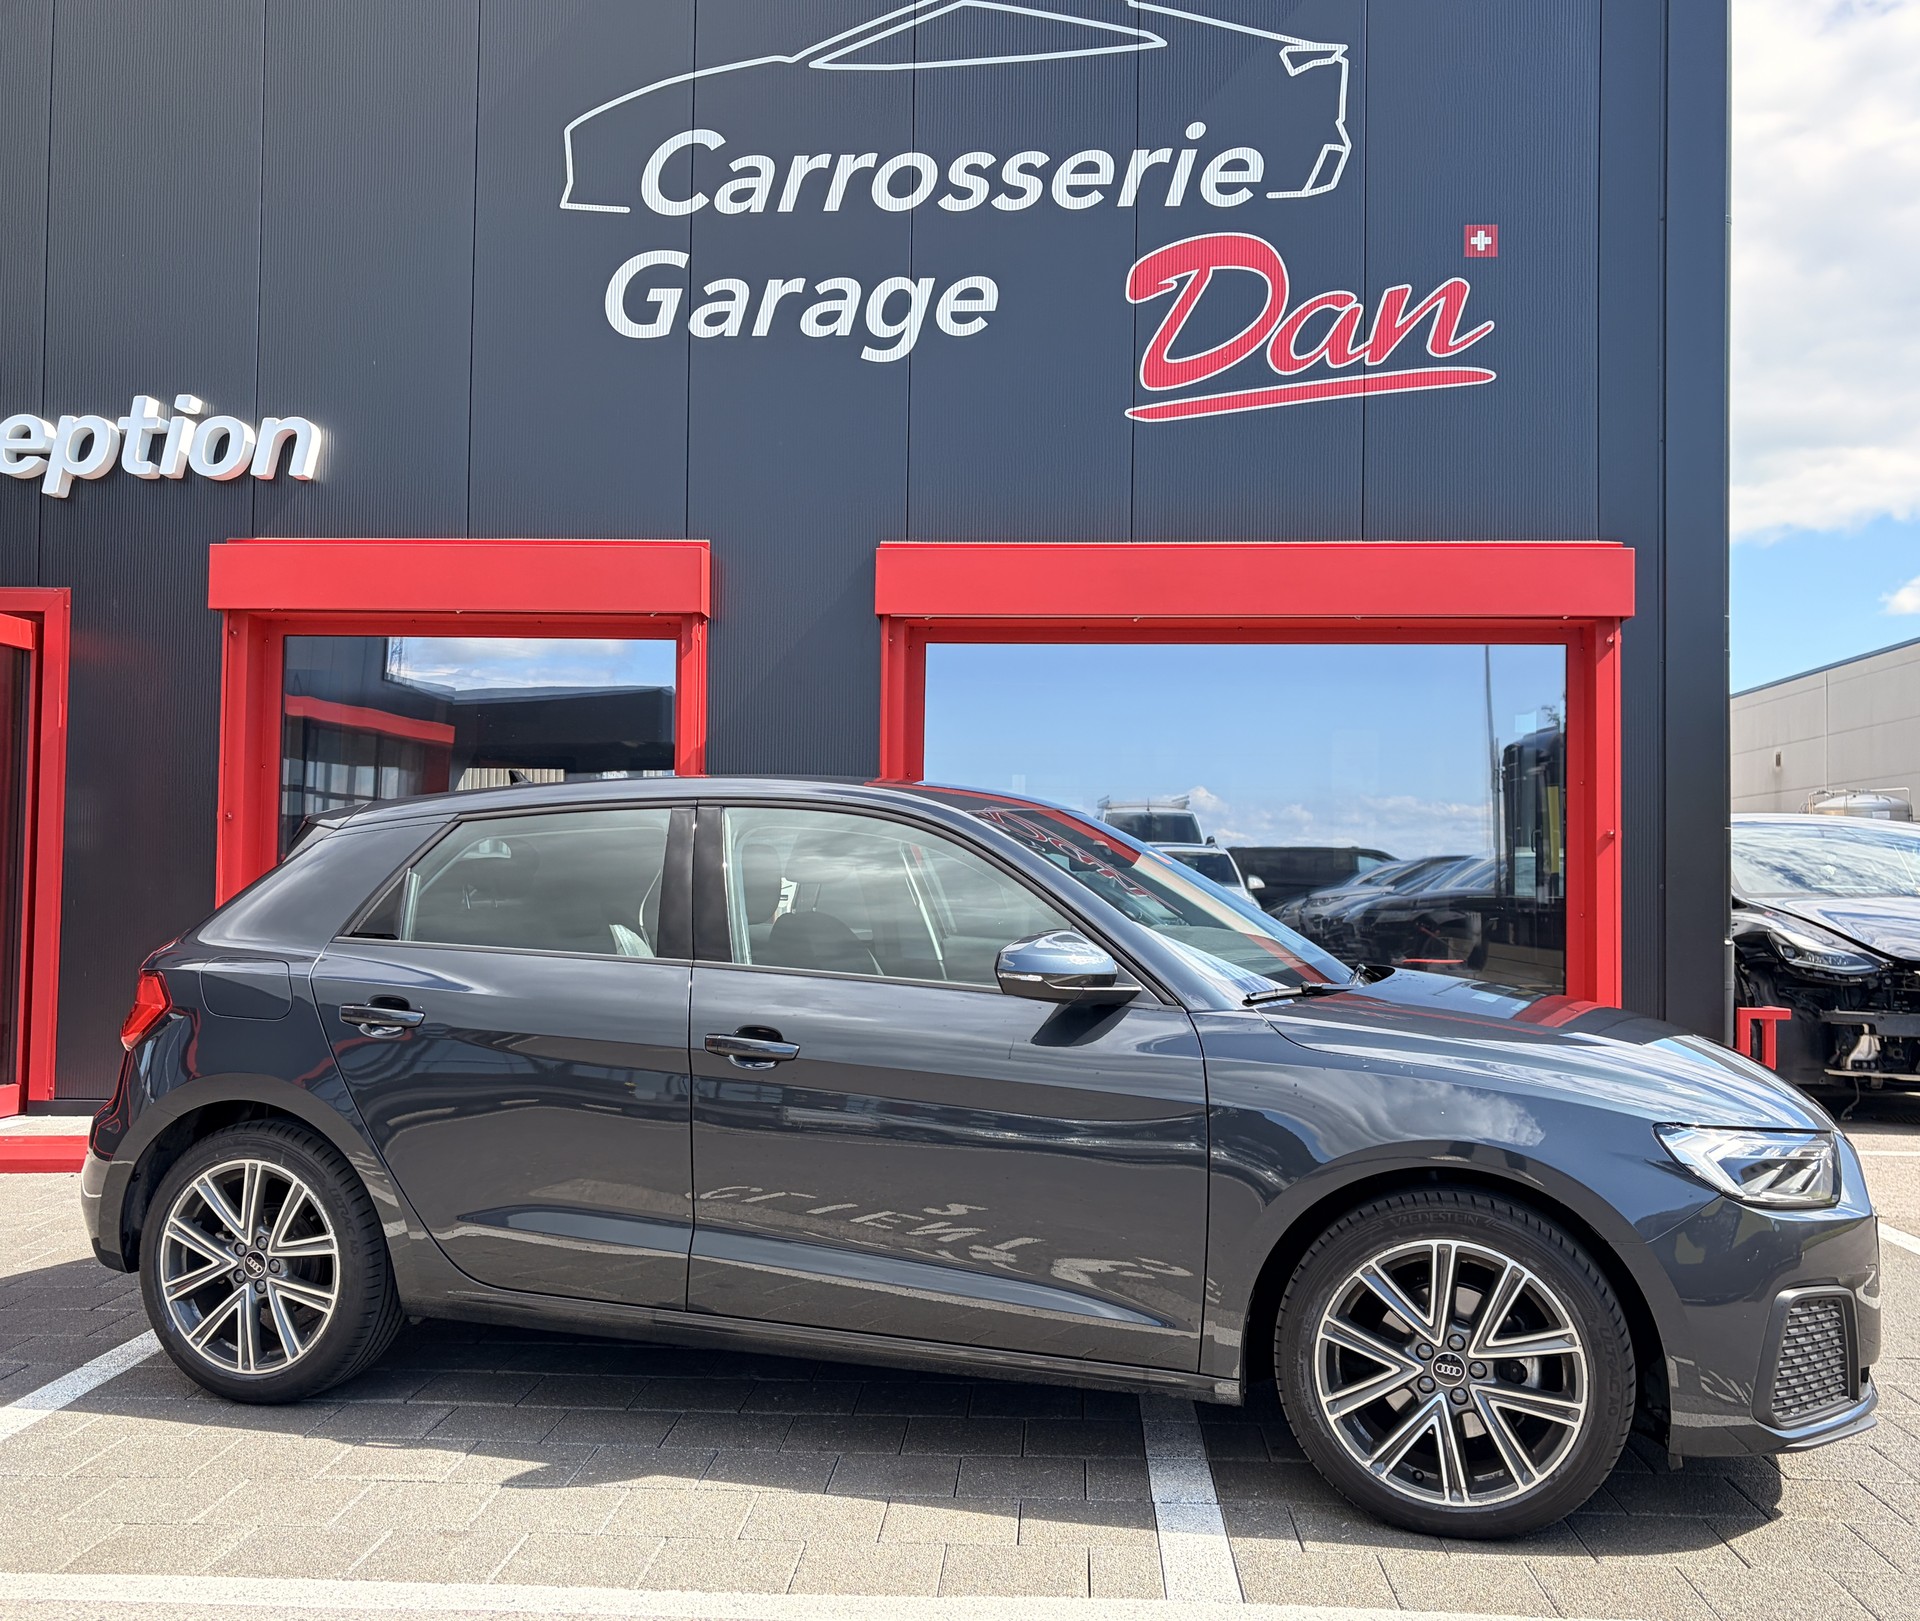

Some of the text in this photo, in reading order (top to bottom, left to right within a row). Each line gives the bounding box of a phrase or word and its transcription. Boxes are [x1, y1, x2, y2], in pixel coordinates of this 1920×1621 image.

[641, 122, 1265, 216] Carrosserie
[605, 250, 998, 362] Garage
[1125, 232, 1495, 391] Dan
[0, 394, 322, 498] eption
[1390, 1210, 1479, 1228] VREDESTEIN
[1598, 1327, 1621, 1393] ULTRAC
